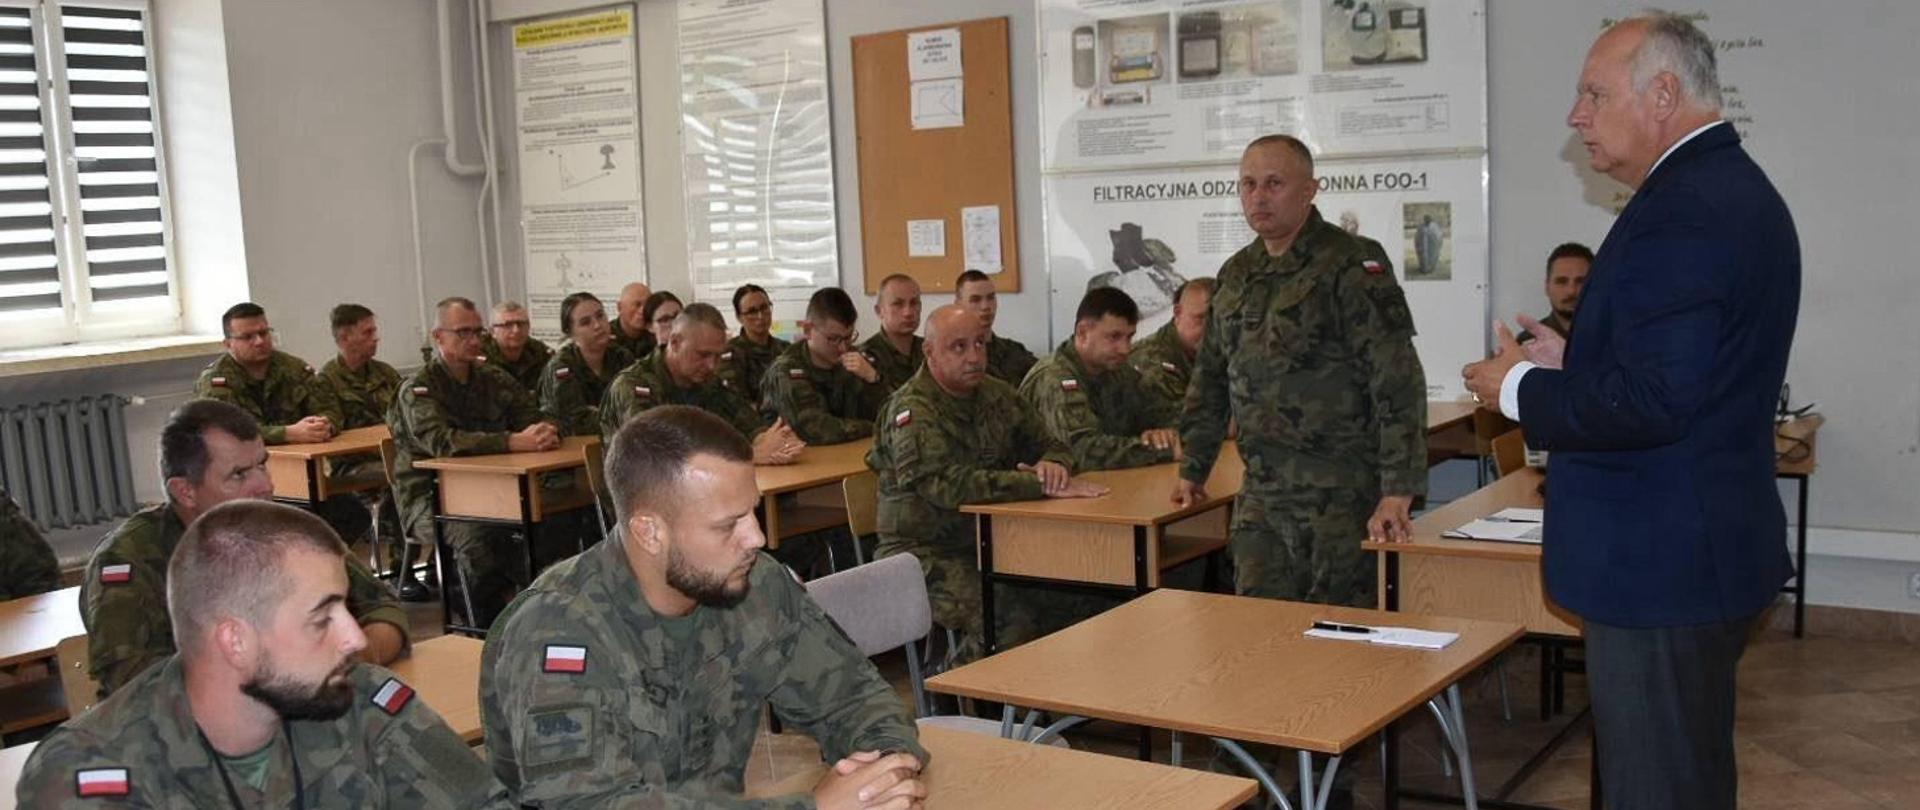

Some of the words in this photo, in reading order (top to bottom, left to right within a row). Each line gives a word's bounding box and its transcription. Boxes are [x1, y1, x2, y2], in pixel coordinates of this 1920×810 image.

[1093, 181, 1198, 201] FILTRACYJNA
[1202, 179, 1241, 197] ODZI
[1319, 174, 1368, 192] ONNA
[1374, 172, 1427, 190] FOO-1
